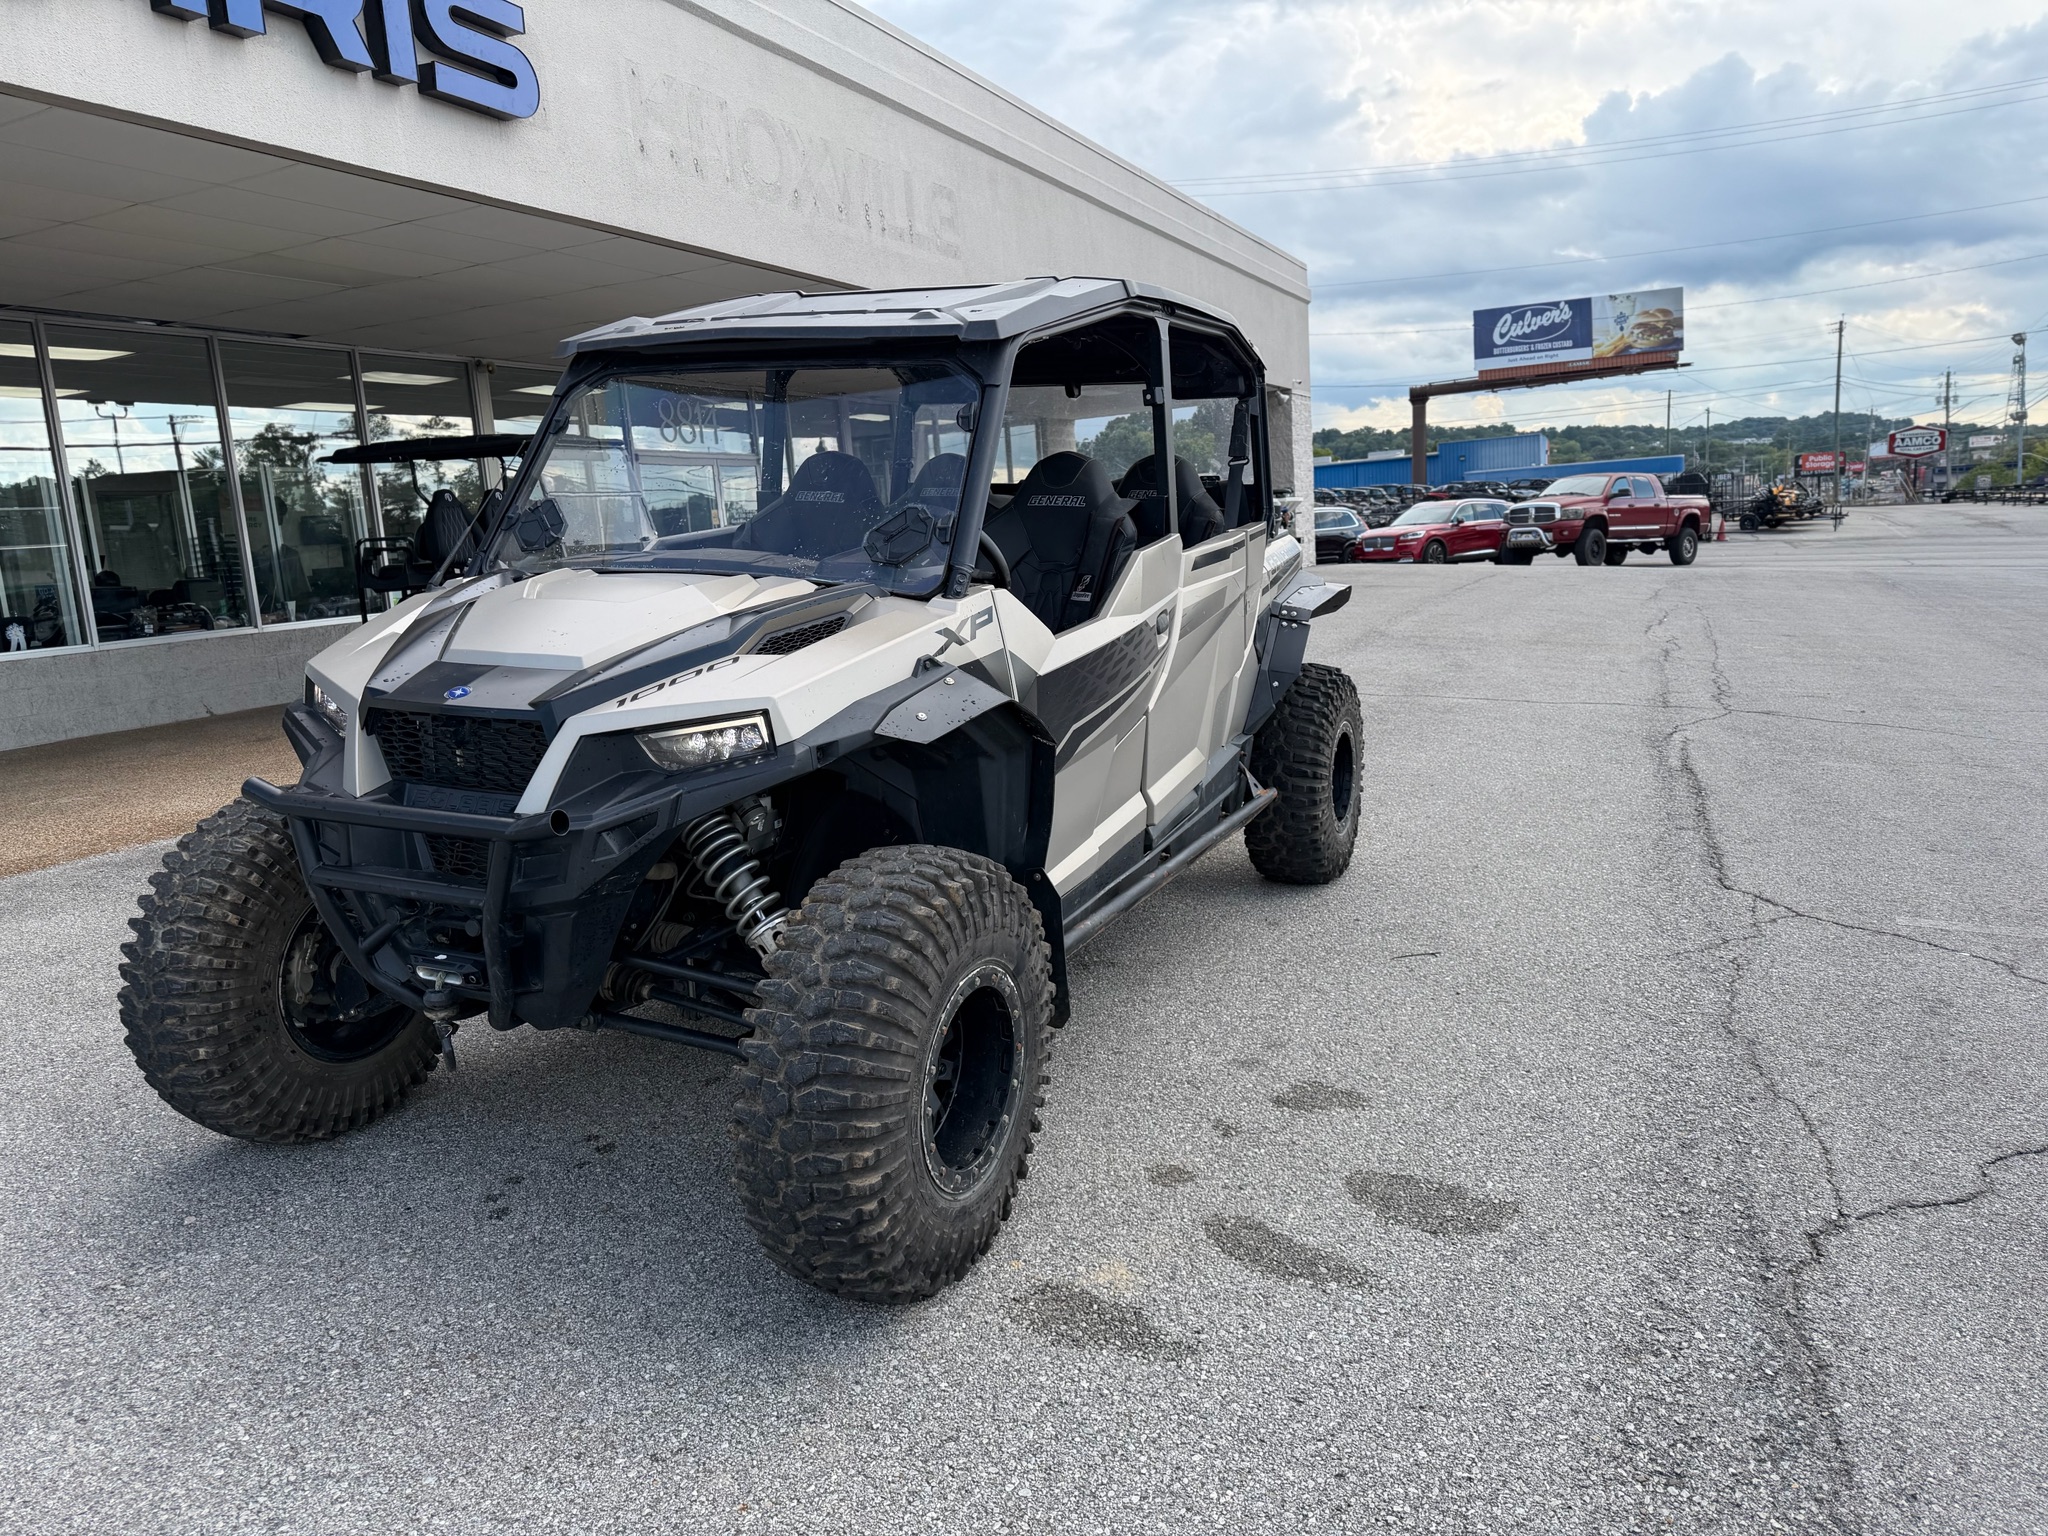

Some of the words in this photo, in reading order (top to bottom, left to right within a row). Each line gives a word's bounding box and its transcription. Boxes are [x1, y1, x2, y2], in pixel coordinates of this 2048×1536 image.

[1493, 301, 1573, 345] Culver's
[1893, 436, 1942, 448] AAMCO
[1809, 454, 1833, 462] Public
[1805, 461, 1836, 469] Storage
[795, 490, 845, 503] GENERAL
[920, 487, 962, 497] GENERA
[1027, 495, 1086, 507] GENERAL
[932, 605, 994, 657] XP
[616, 655, 741, 708] 1000
